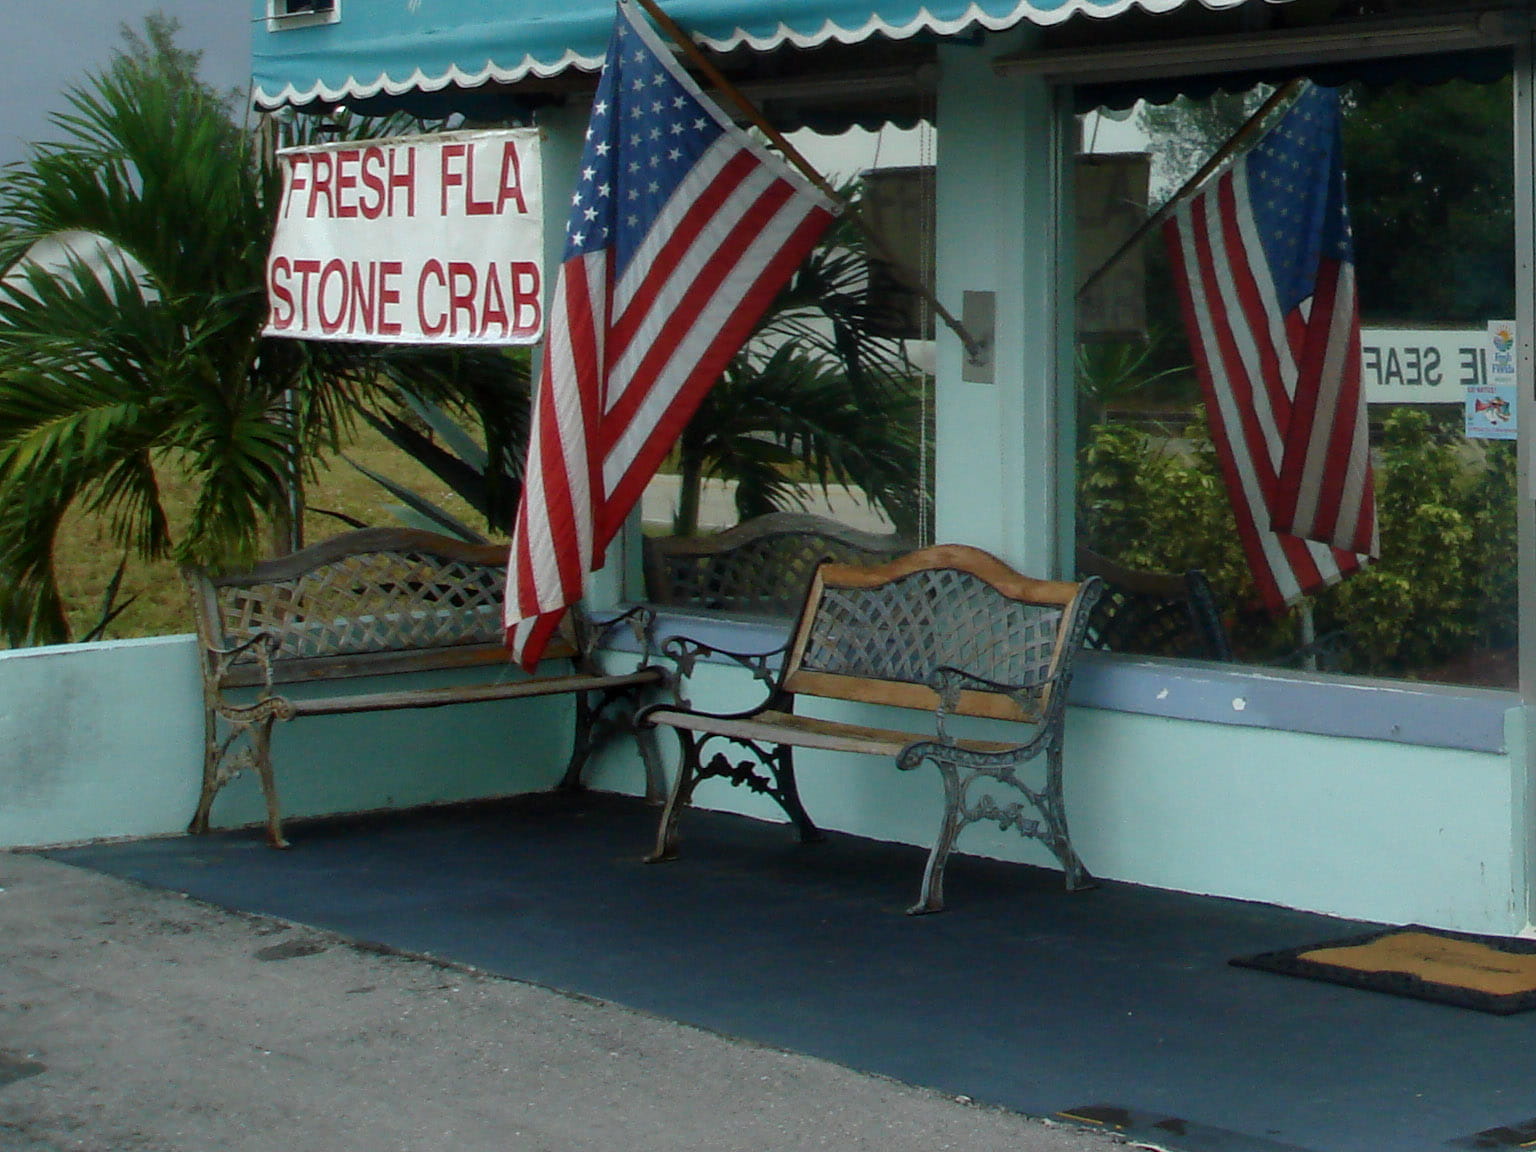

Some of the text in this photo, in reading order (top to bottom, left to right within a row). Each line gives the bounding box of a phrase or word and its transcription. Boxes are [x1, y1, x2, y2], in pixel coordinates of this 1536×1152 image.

[284, 140, 529, 219] FRESH FLA
[270, 256, 542, 338] STONE CRAB
